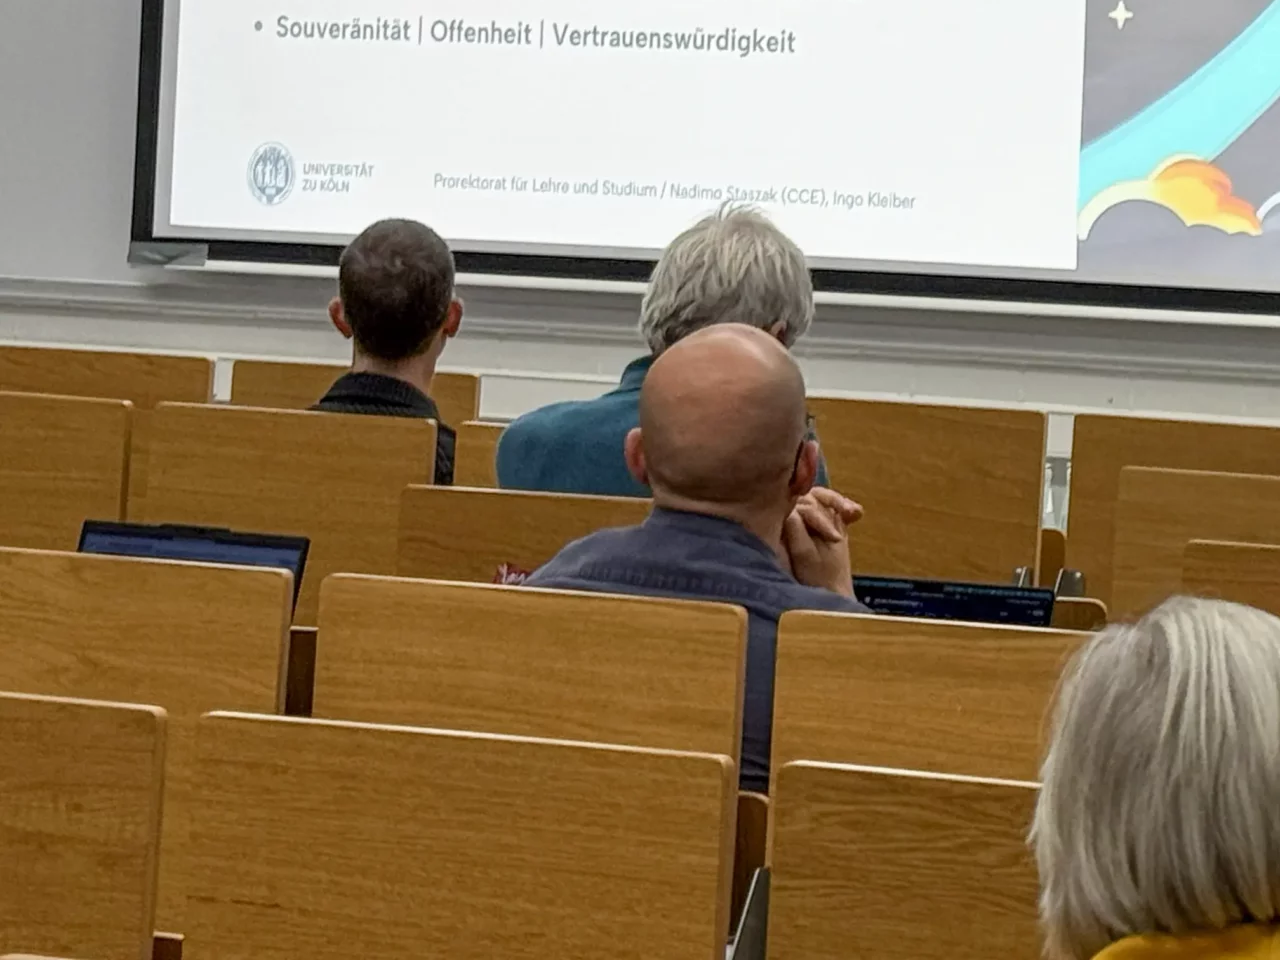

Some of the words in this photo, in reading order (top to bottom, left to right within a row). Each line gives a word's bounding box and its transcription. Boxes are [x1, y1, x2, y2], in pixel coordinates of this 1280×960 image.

[277, 15, 411, 41] Souveränität
[430, 19, 532, 45] Offenheit
[553, 23, 796, 58] Vertrauenswürdigkeit
[303, 162, 374, 177] UNIVERSITÄT
[302, 179, 317, 192] ZU
[321, 178, 350, 192] KÖLN
[434, 173, 507, 191] Prorektorat
[511, 176, 528, 191] für
[532, 177, 569, 194] Lehre
[574, 179, 598, 195] und
[602, 180, 657, 197] Studium
[833, 190, 864, 210] Ingo
[868, 192, 916, 209] Kleiber
